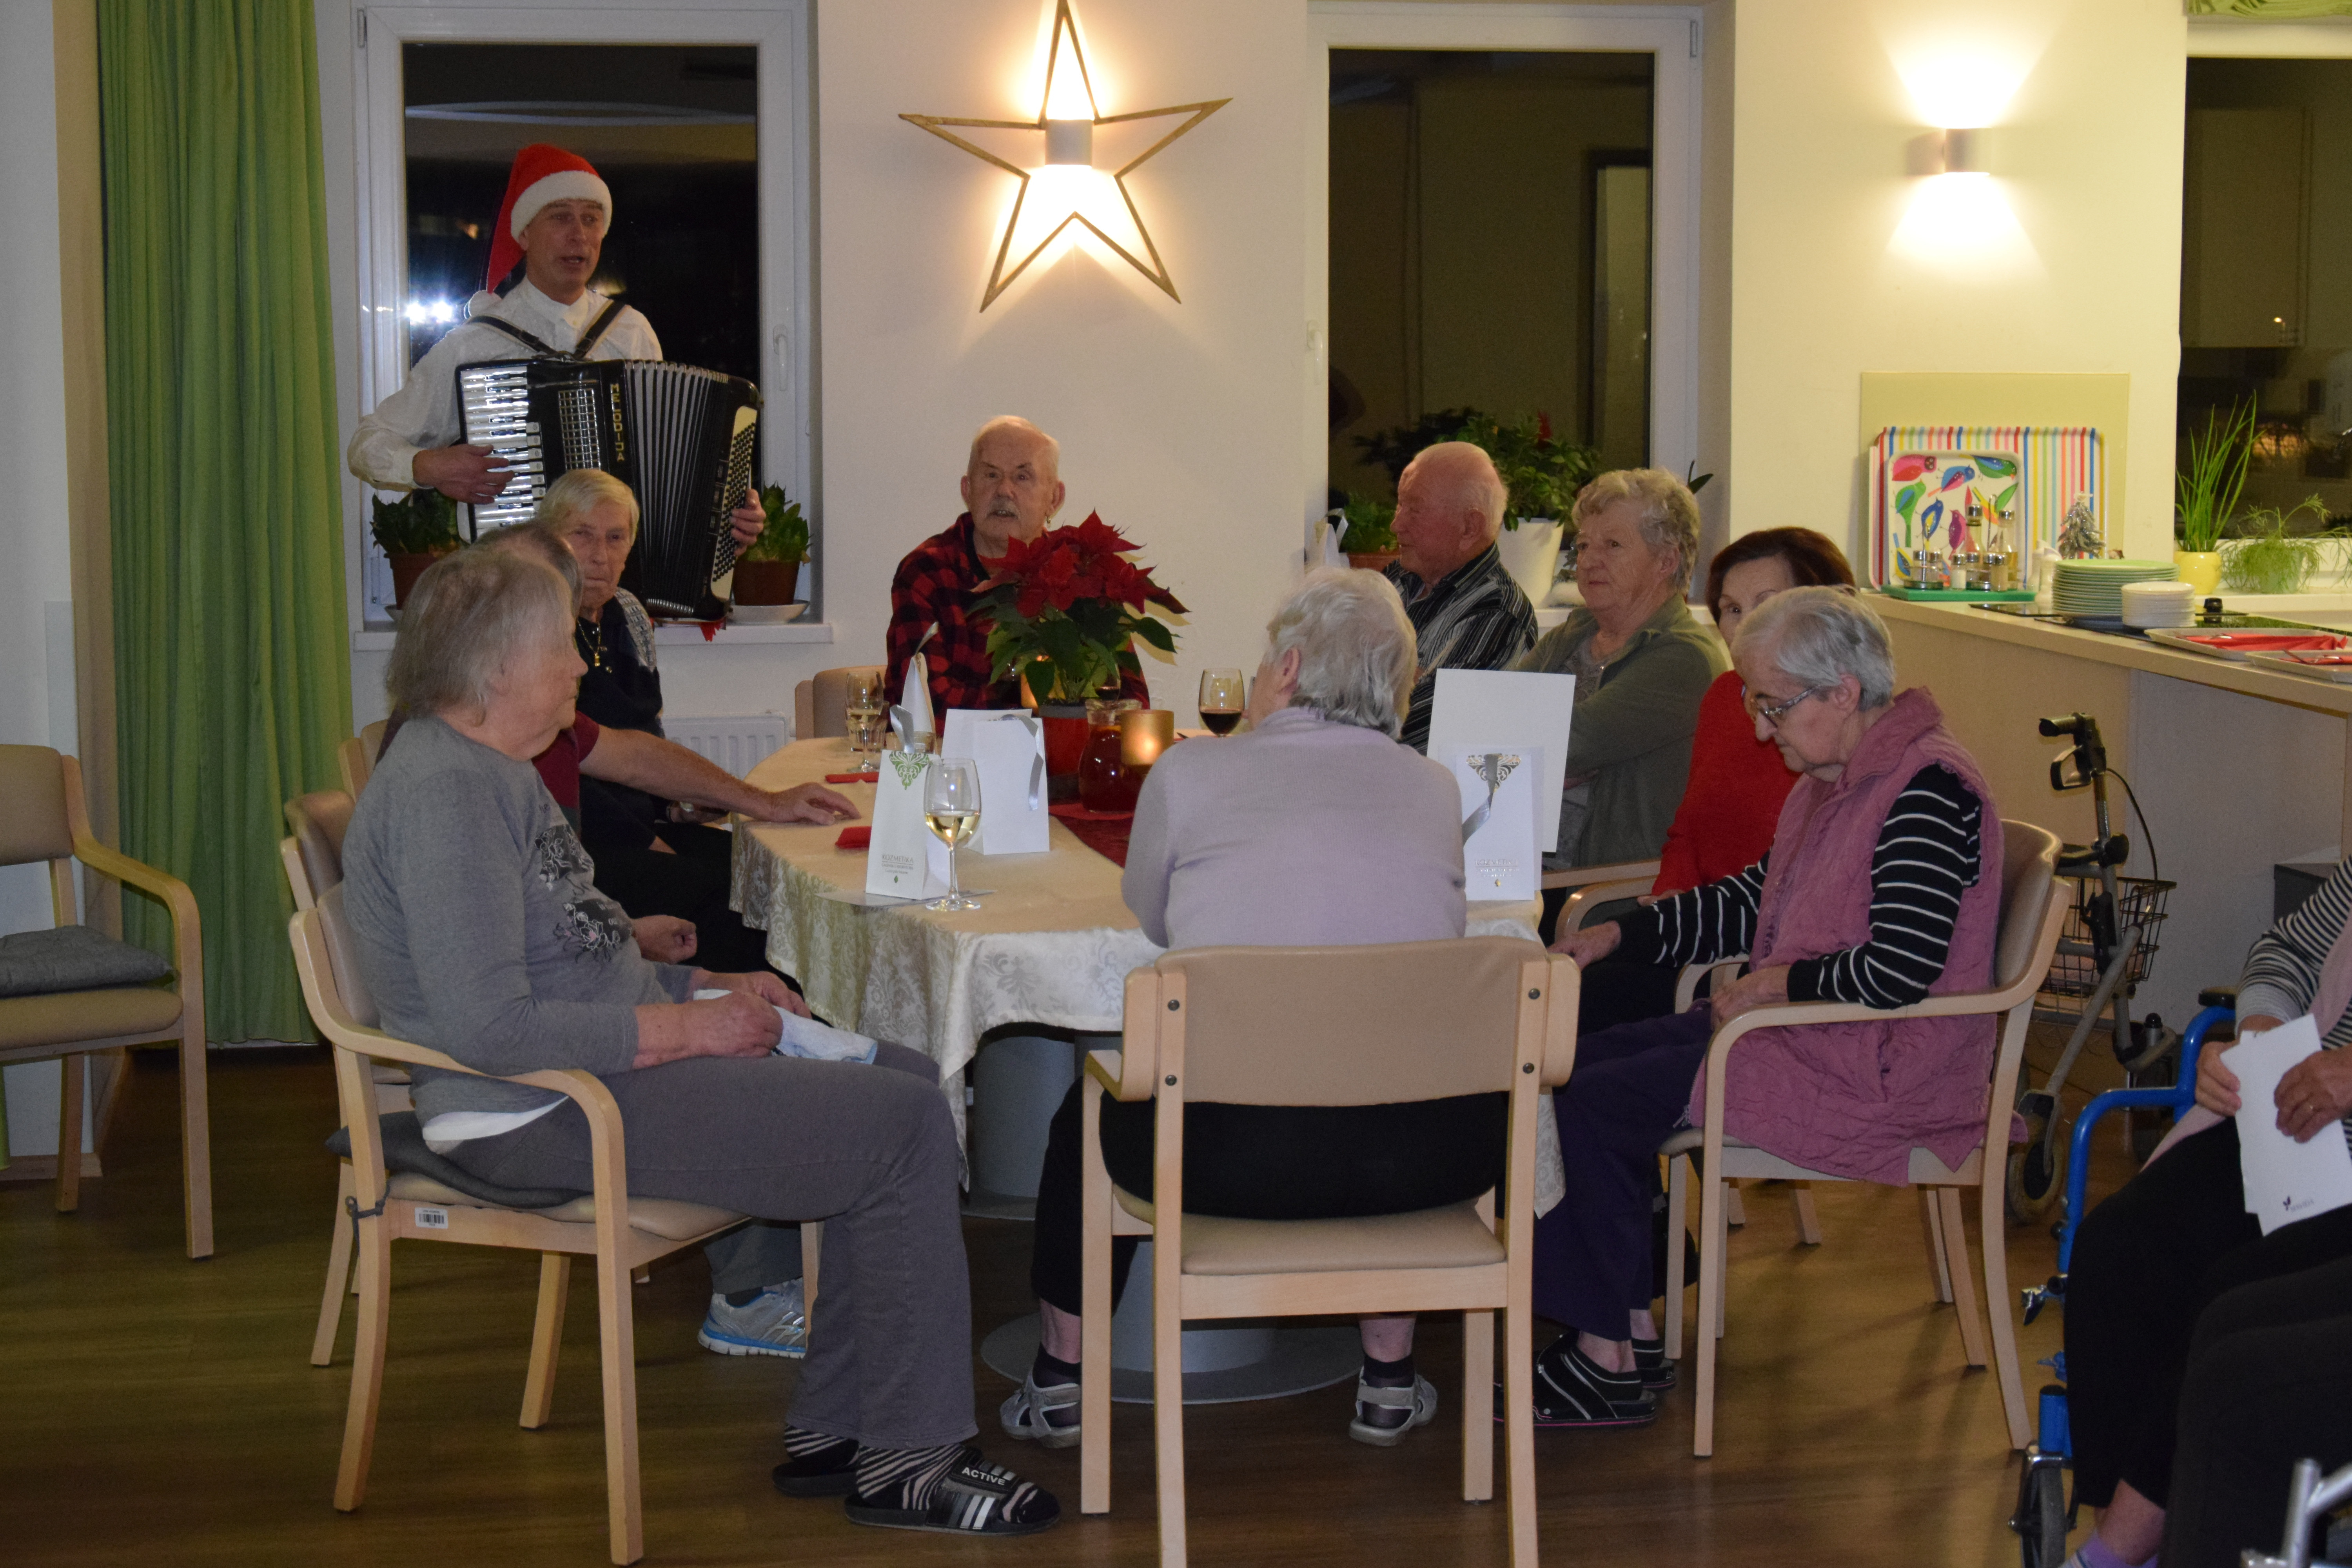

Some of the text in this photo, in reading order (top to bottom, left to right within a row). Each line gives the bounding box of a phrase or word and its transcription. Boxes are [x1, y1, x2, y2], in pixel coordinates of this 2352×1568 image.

[610, 383, 625, 462] MELODIJA
[882, 854, 914, 863] KOZMETIKA
[962, 1467, 1005, 1485] ACTIVE
